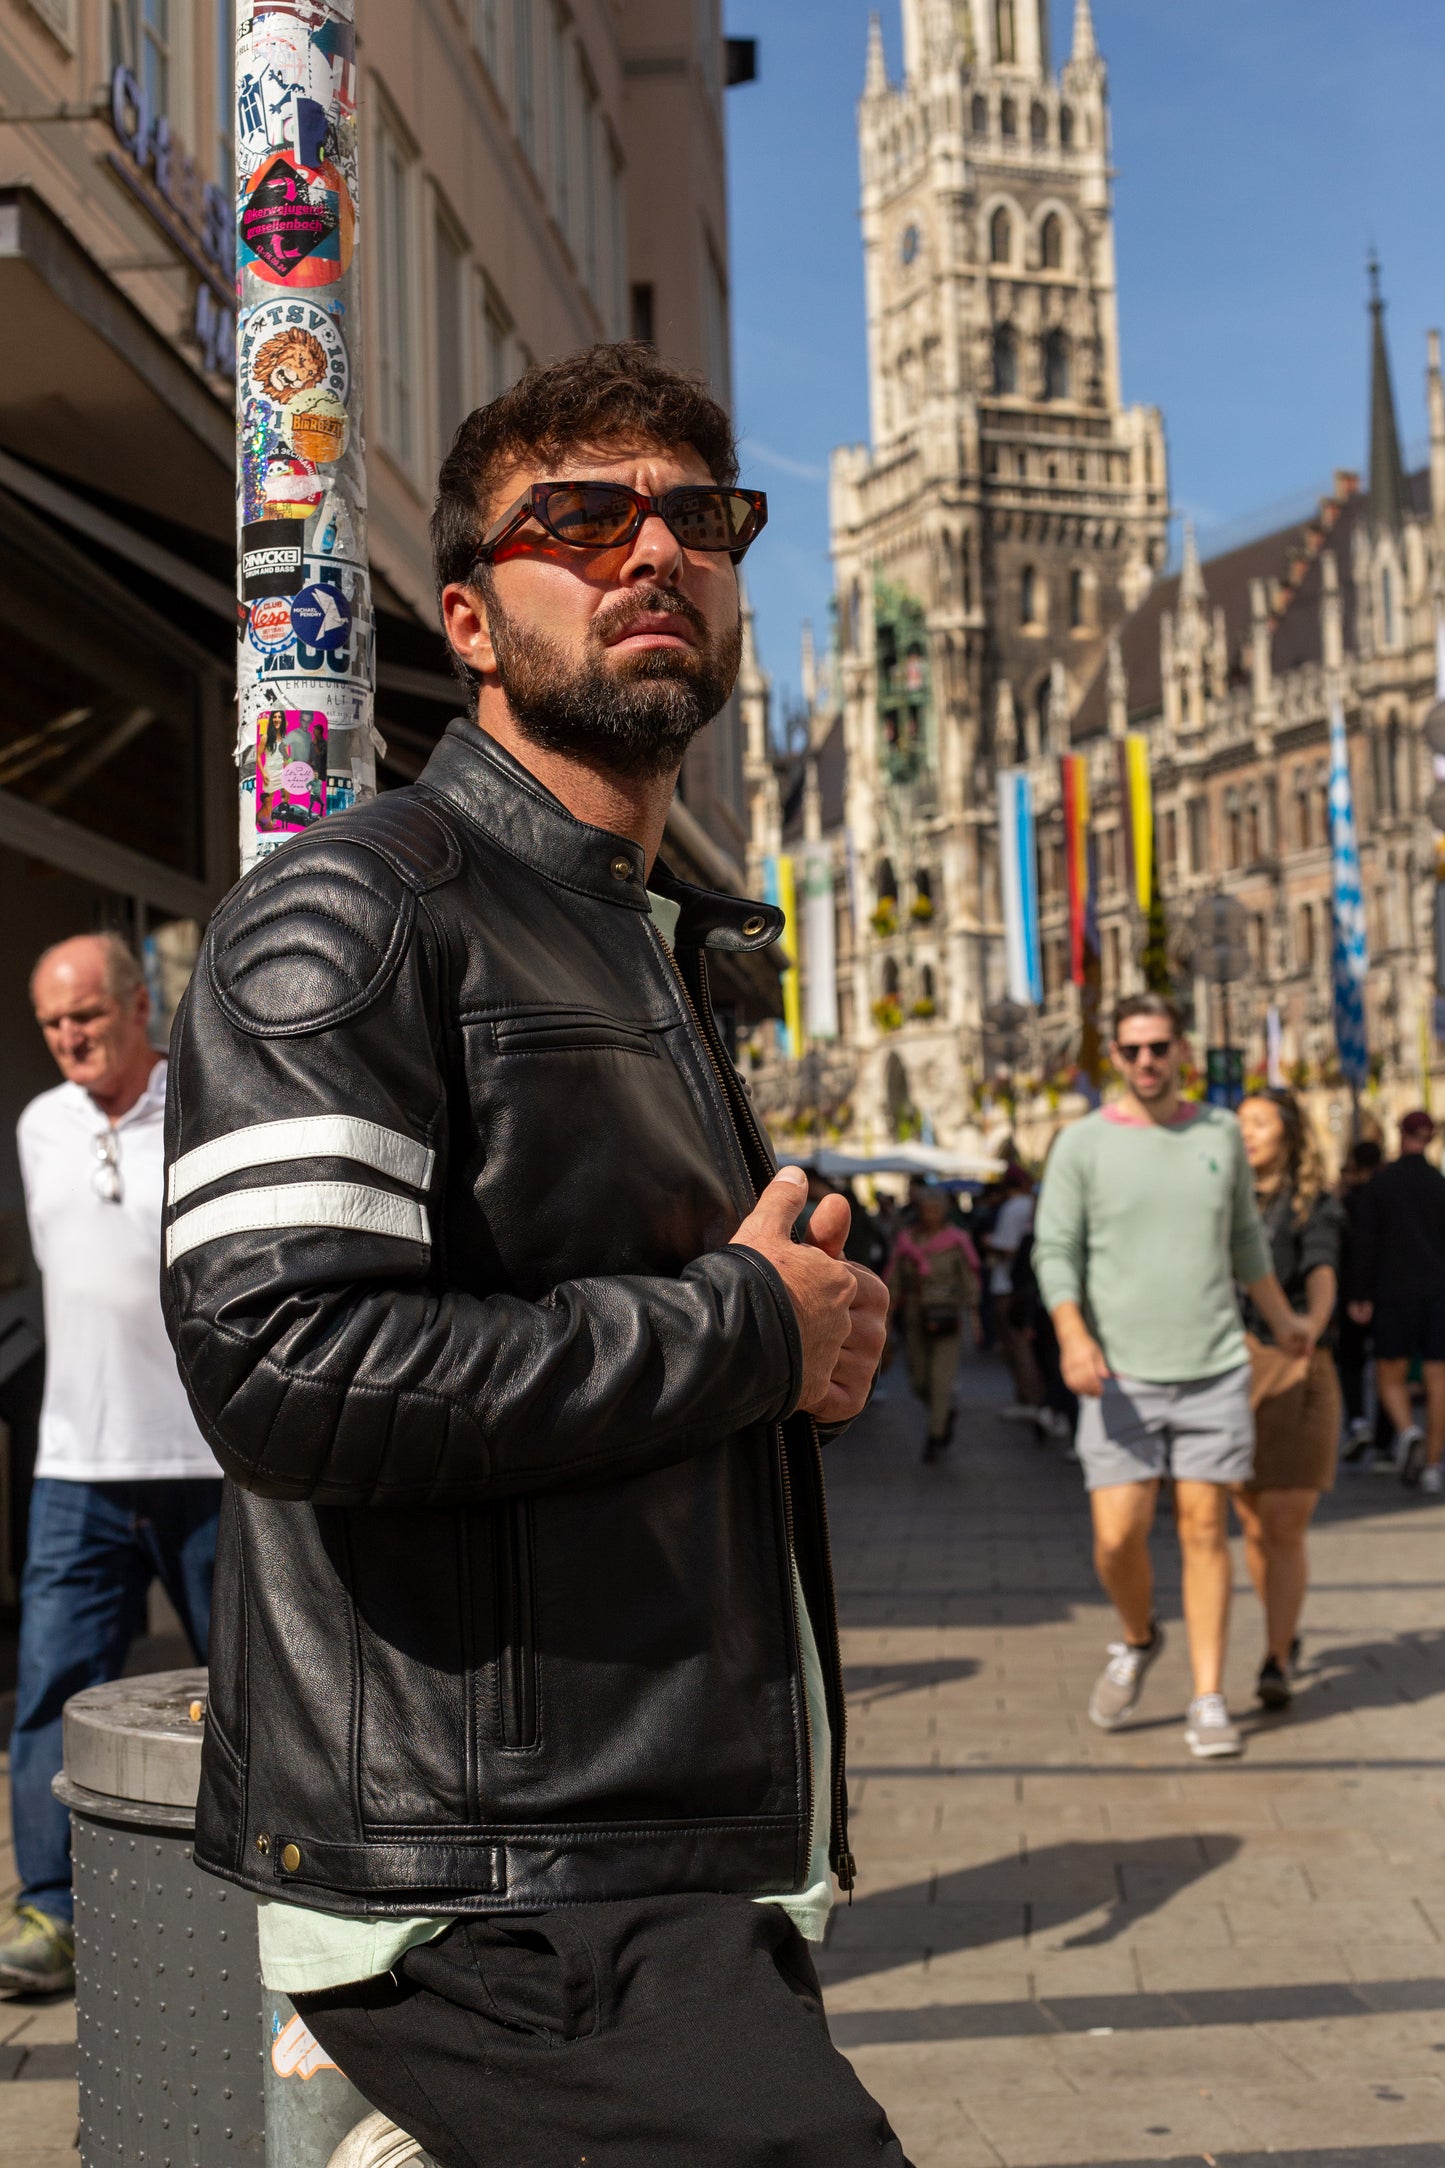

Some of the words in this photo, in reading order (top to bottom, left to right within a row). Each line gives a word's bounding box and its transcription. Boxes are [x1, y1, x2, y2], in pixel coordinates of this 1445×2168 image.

[246, 218, 323, 240] grasellenbach
[266, 304, 327, 331] TSV
[245, 570, 260, 579] DRUM
[260, 567, 274, 575] AND
[263, 601, 283, 610] CLUB
[251, 606, 291, 629] Vesp
